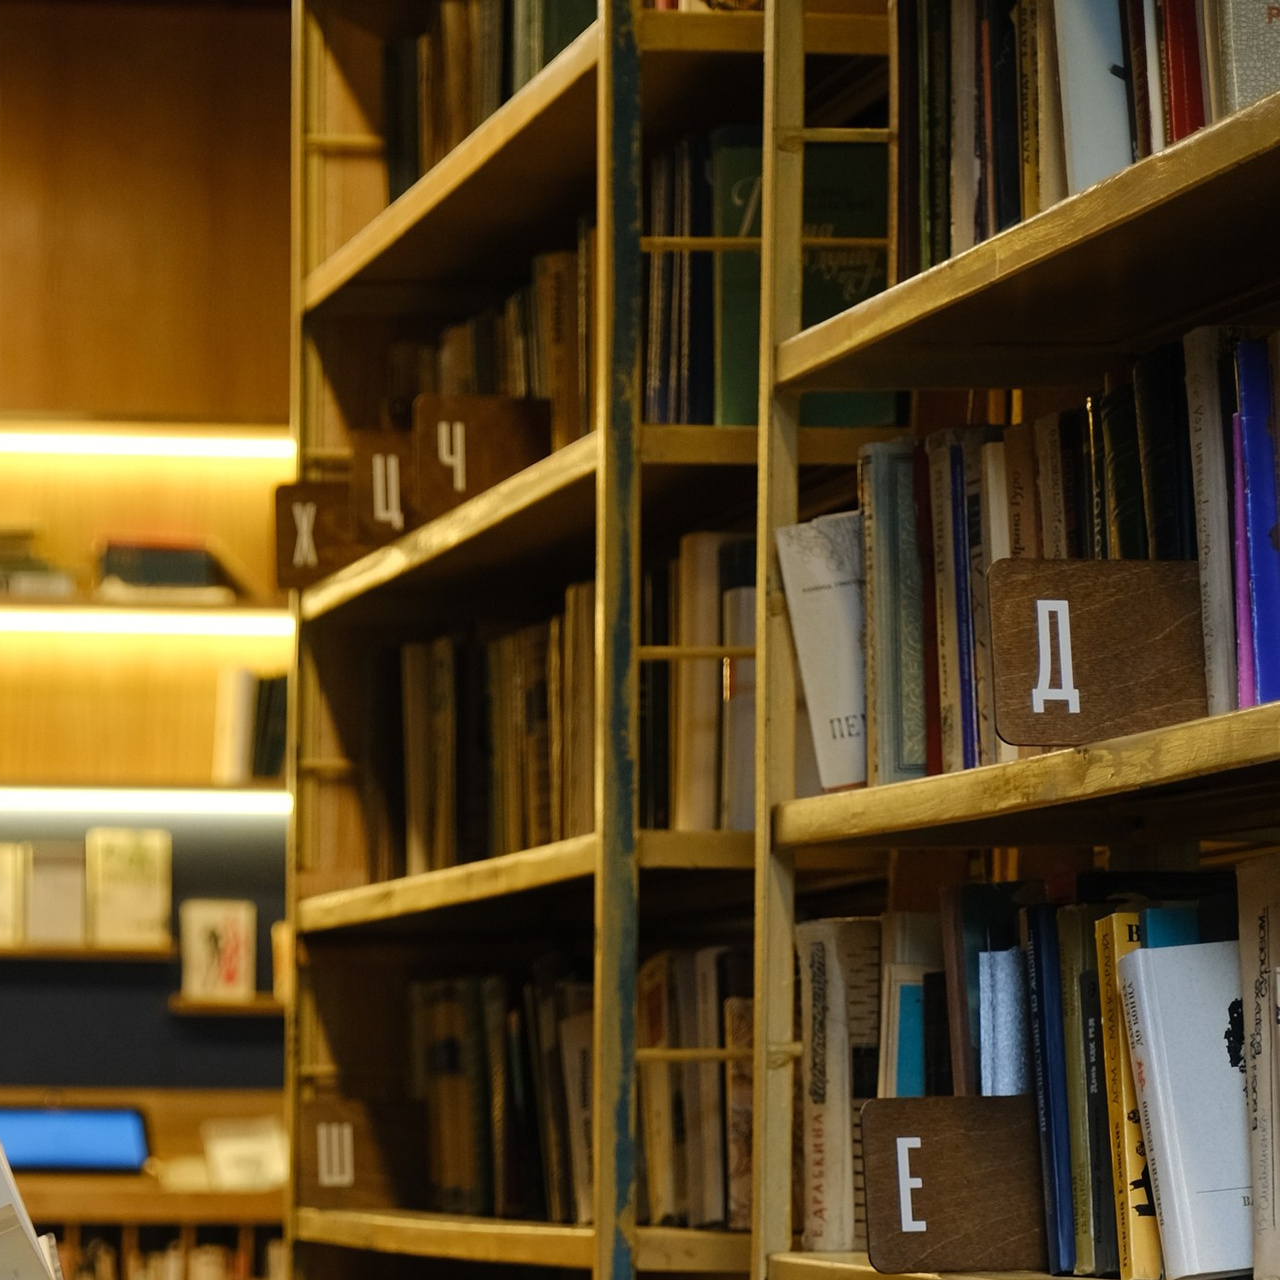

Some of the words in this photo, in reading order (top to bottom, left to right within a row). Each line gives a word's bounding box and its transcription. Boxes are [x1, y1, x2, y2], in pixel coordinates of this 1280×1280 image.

[437, 420, 467, 493] Ч
[1010, 470, 1024, 507] Гуро
[291, 500, 319, 568] Х
[372, 472, 405, 532] Ц
[1032, 599, 1081, 713] Д
[828, 714, 866, 740] ПЕ
[1031, 994, 1040, 1013] ИЗ
[1100, 932, 1117, 1041] МАНСАРДОЙ
[1128, 982, 1140, 1024] КОНЦА
[1108, 1049, 1118, 1061] С
[1134, 1029, 1144, 1047] ДО
[1034, 1019, 1048, 1132] ПРОИСШЕСТВИЕ
[1110, 1069, 1121, 1105] ДОМ
[315, 1121, 355, 1188] Ш
[811, 1113, 827, 1221] ДРАБКИНА
[896, 1137, 928, 1232] Е
[1150, 1156, 1165, 1227] ВАЛЕНТИН
